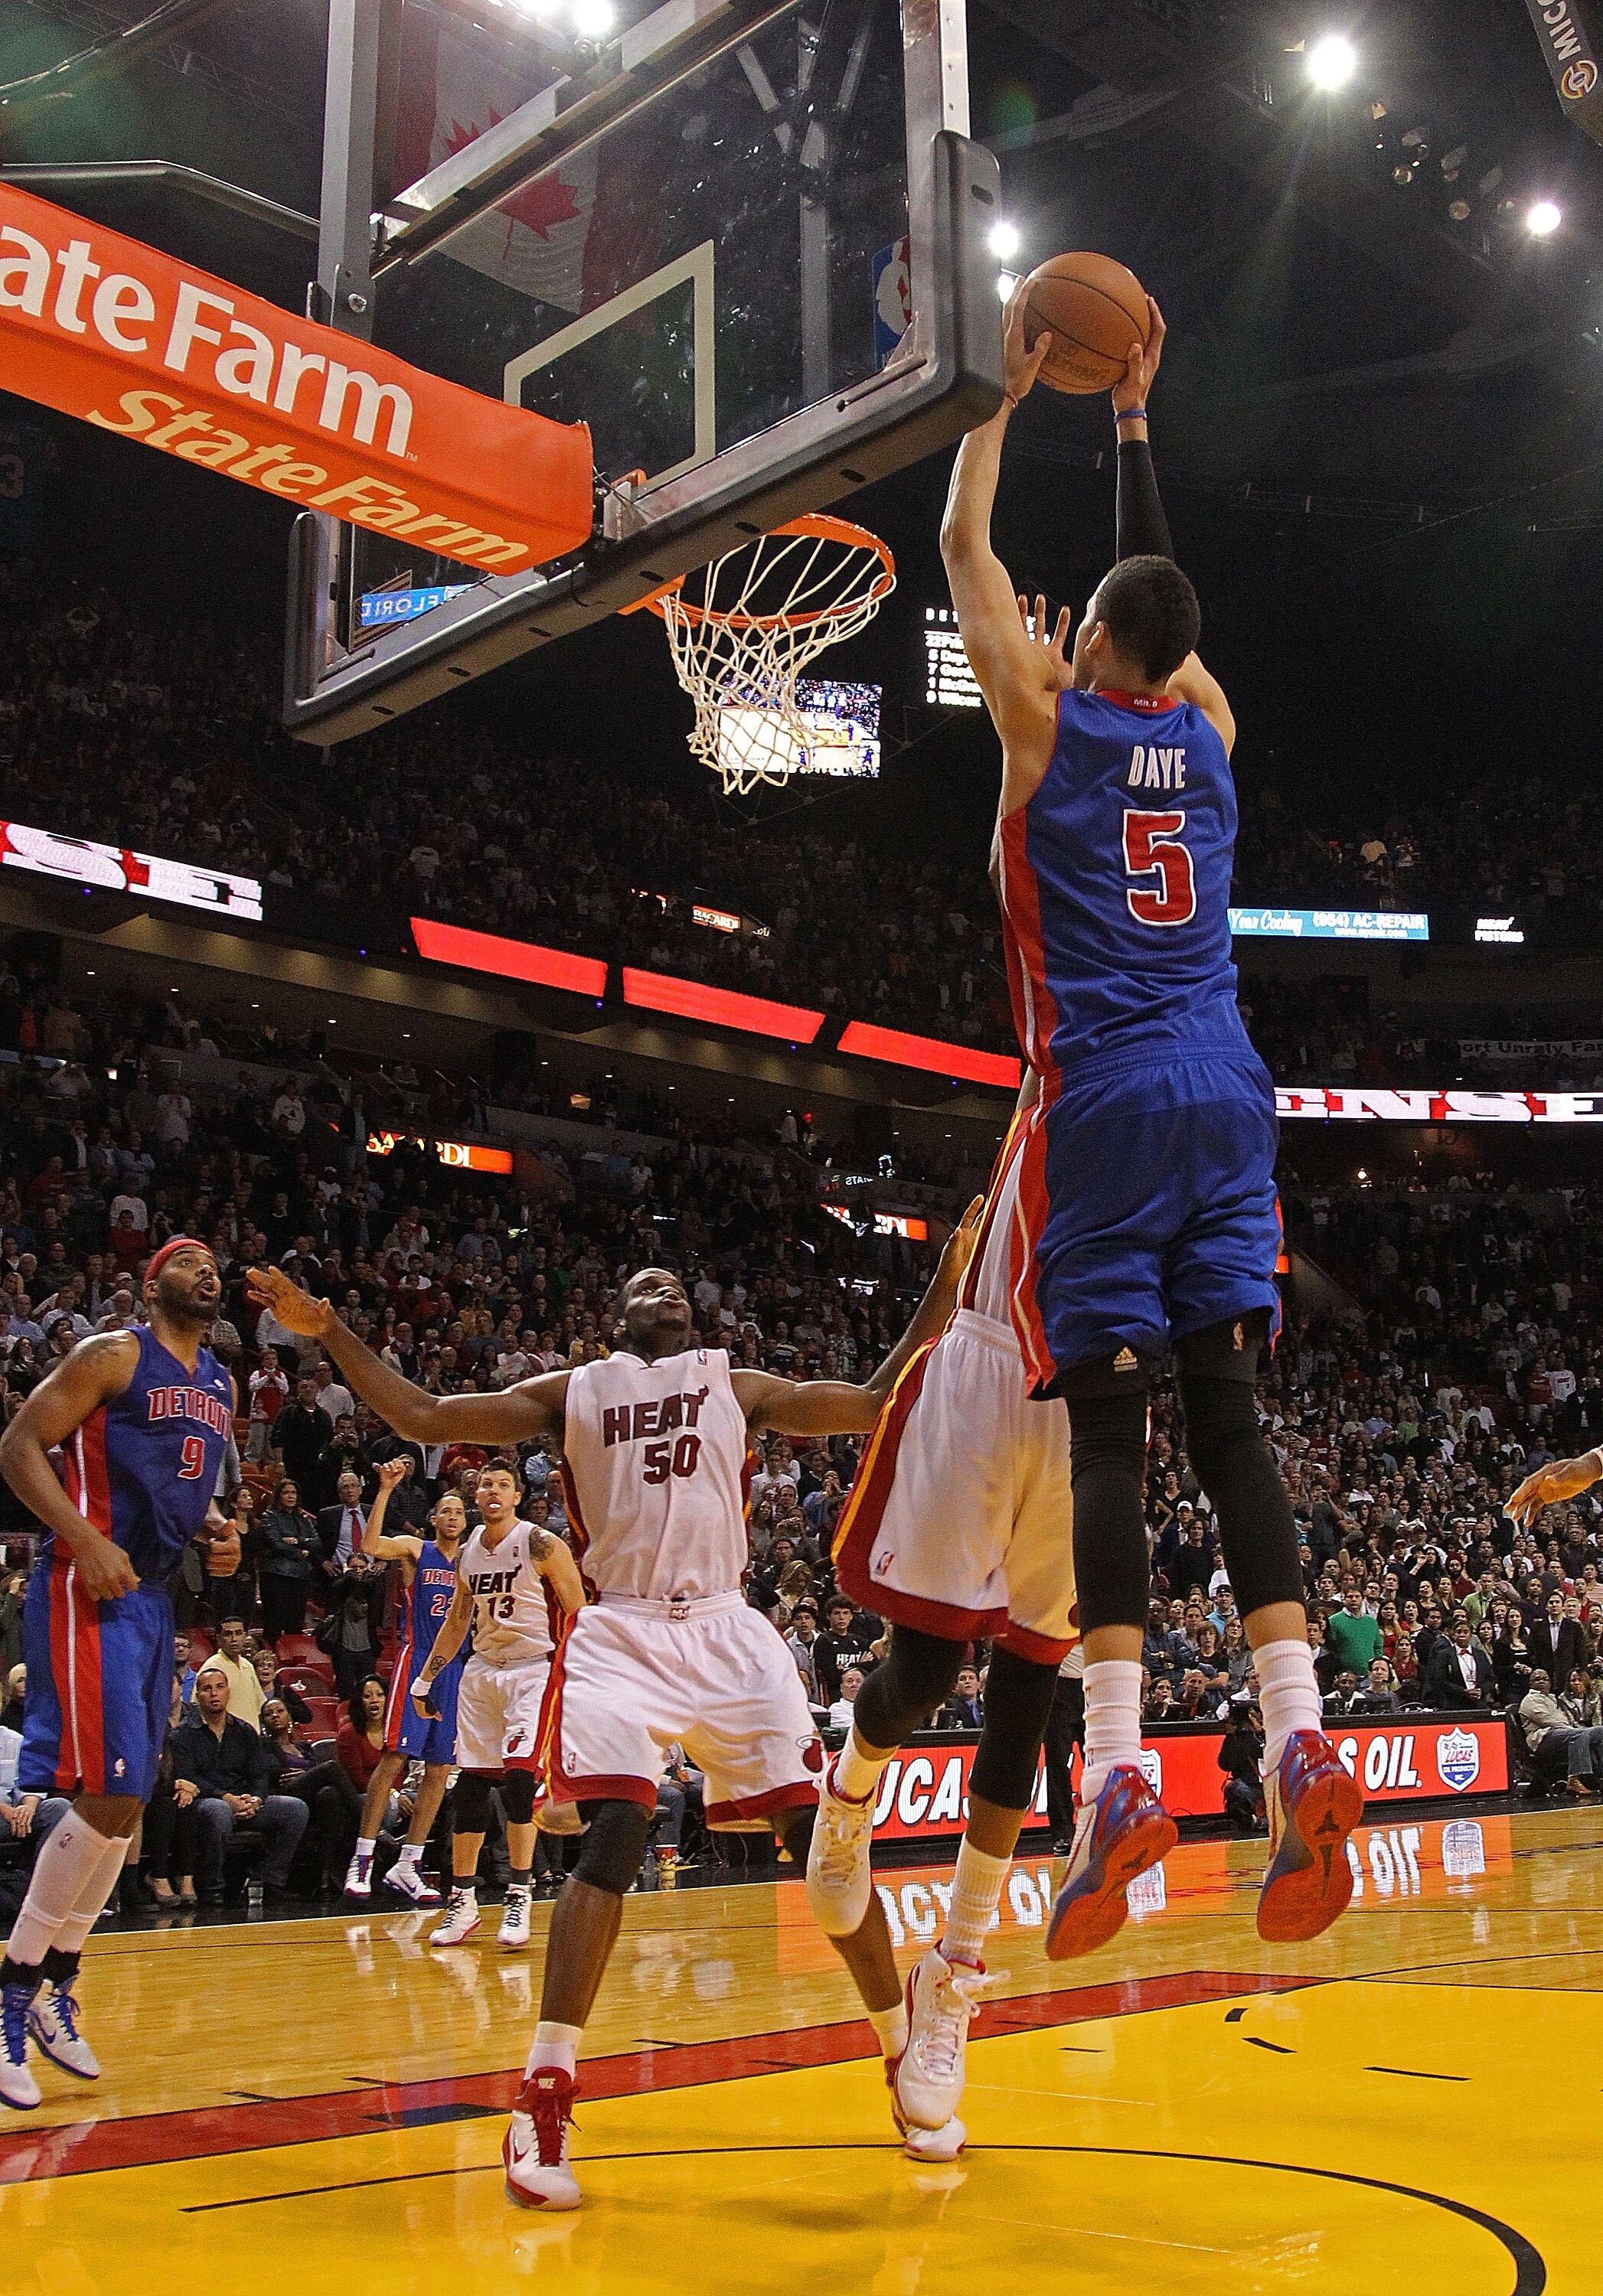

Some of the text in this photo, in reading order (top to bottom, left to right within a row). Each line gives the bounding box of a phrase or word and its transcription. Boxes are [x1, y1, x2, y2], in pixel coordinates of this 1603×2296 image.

[1536, 0, 1582, 61] MIC
[164, 281, 413, 458] Farm
[85, 390, 530, 564] State Farm
[1128, 745, 1186, 790] DAYE
[1122, 808, 1197, 927] 5
[147, 1386, 230, 1442] DETROIT
[603, 1384, 710, 1448] HEAT
[177, 1436, 205, 1479] 9
[643, 1433, 702, 1486] 50
[468, 1564, 522, 1596] HEAT
[487, 1595, 515, 1619] 13
[835, 1651, 862, 1665] HEAT
[1364, 1735, 1417, 1791] OIL
[872, 1756, 971, 1827] UCA
